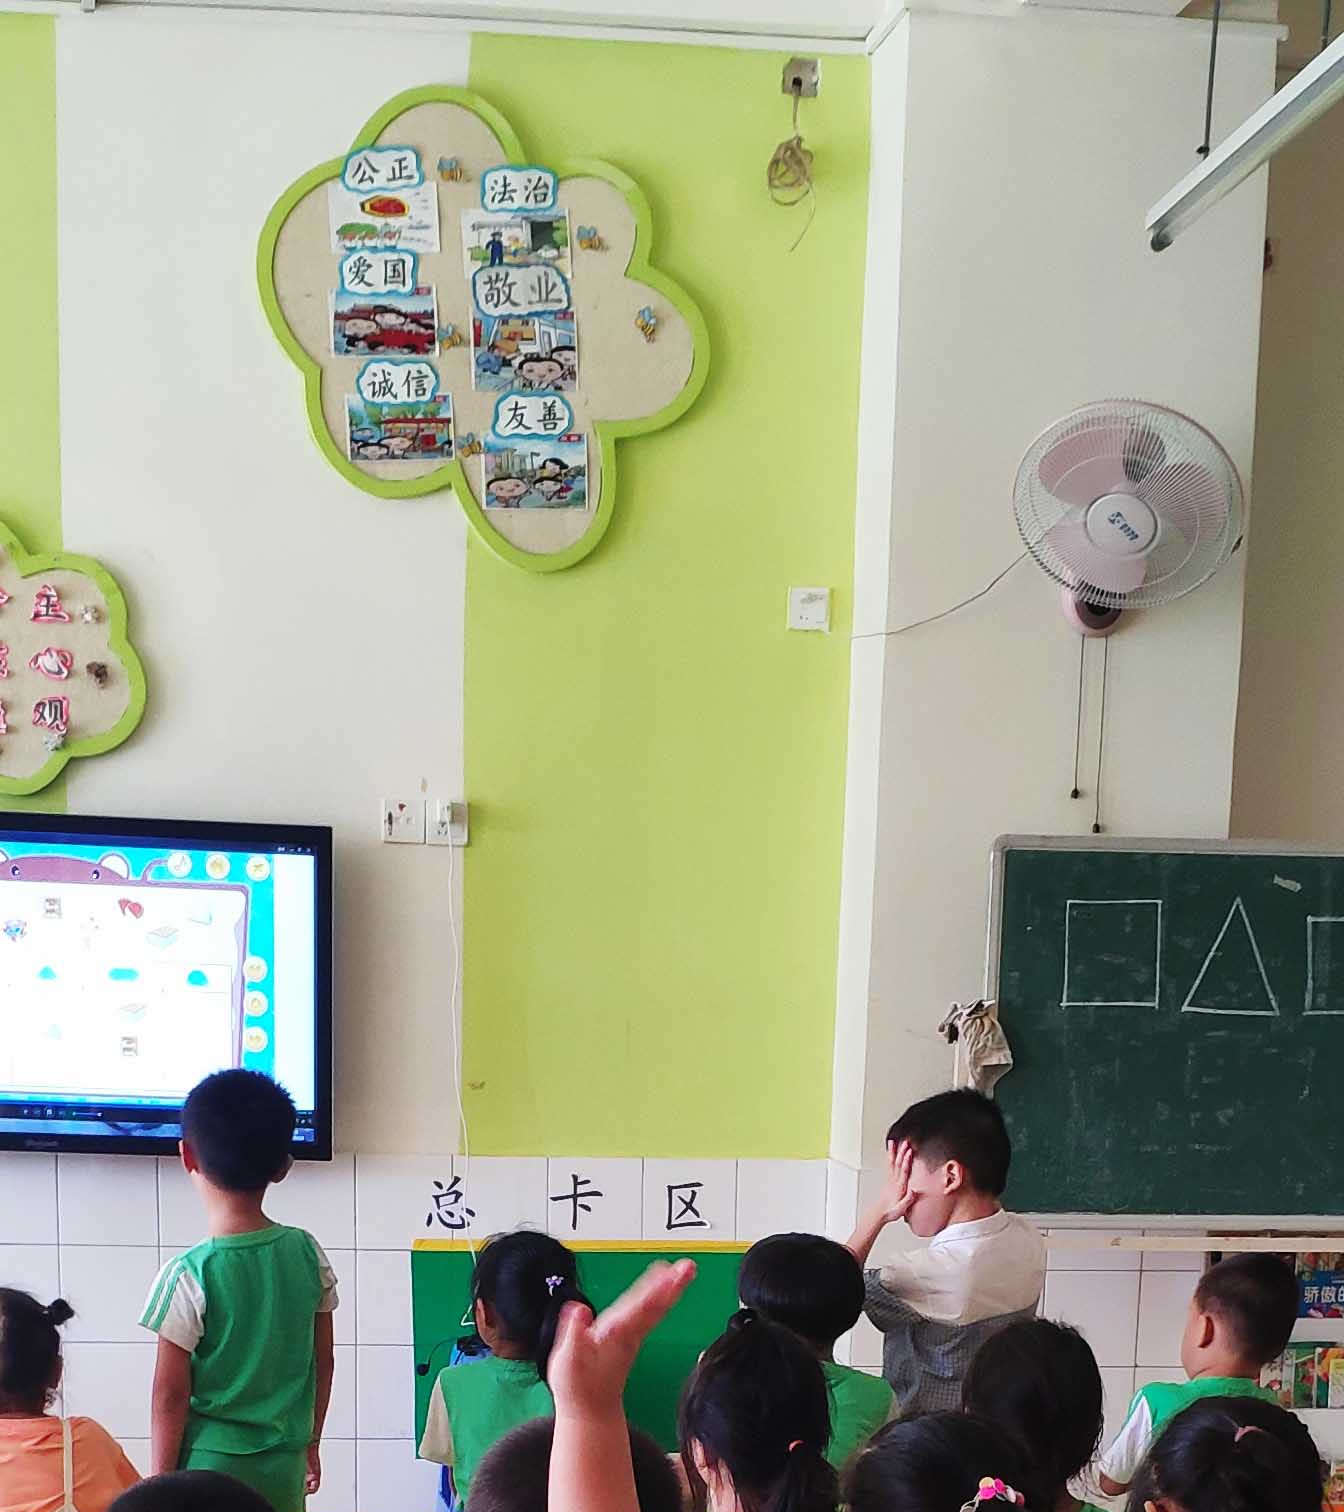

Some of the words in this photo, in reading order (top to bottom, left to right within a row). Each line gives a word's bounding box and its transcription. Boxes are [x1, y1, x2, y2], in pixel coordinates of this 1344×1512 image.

[352, 155, 416, 184] 公正
[489, 176, 551, 206] 法治
[346, 256, 407, 287] 爱国
[482, 272, 563, 309] 敬业
[367, 371, 431, 400] 诚信
[504, 400, 565, 431] 友善
[426, 1174, 710, 1231] 总卡区
